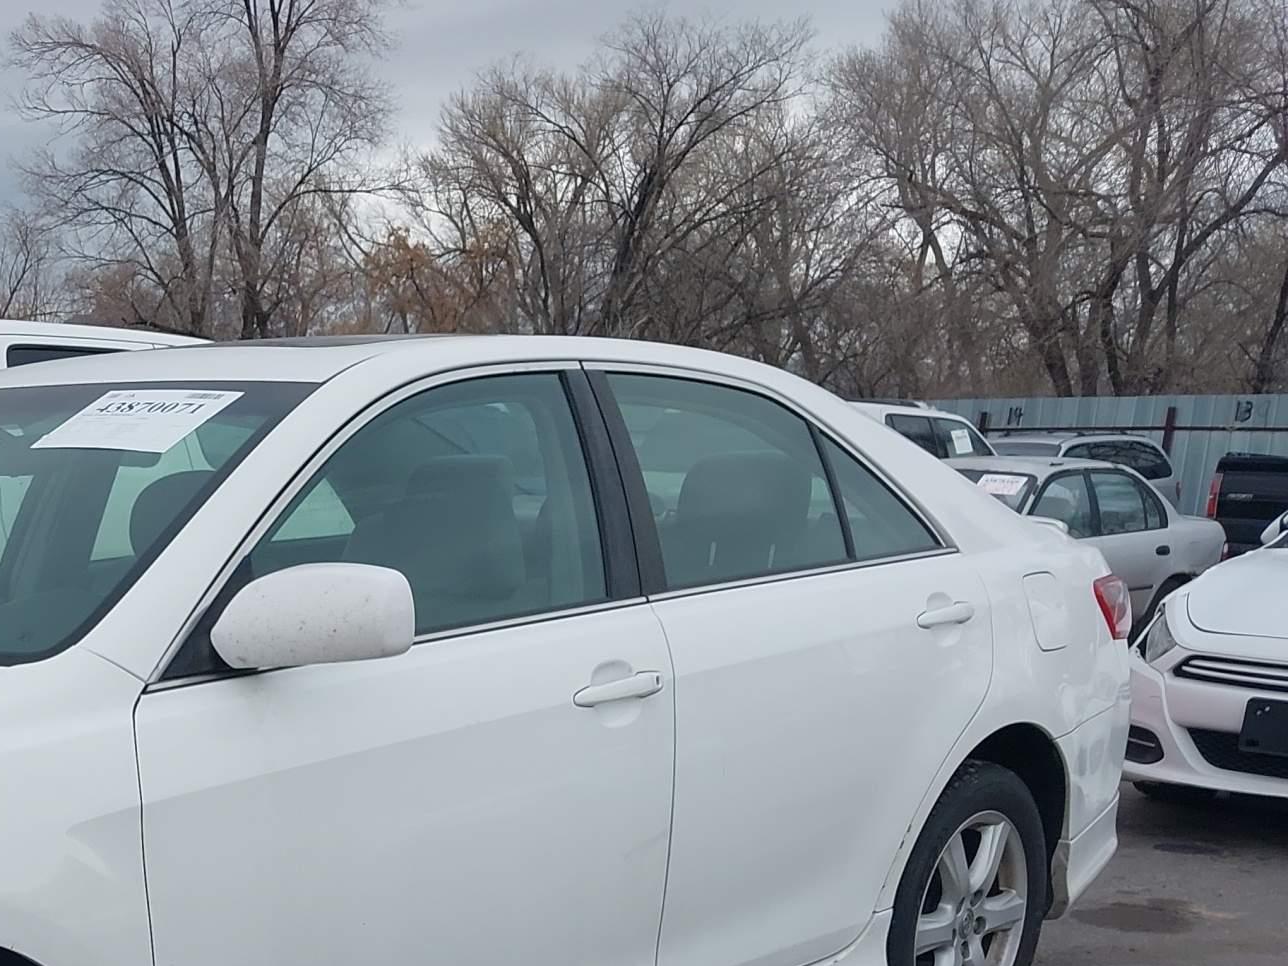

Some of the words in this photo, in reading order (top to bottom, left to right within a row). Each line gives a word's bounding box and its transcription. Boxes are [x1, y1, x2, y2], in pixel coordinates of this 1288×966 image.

[95, 401, 206, 415] 43870071
[1007, 407, 1024, 426] 14
[1234, 400, 1254, 423] 13
